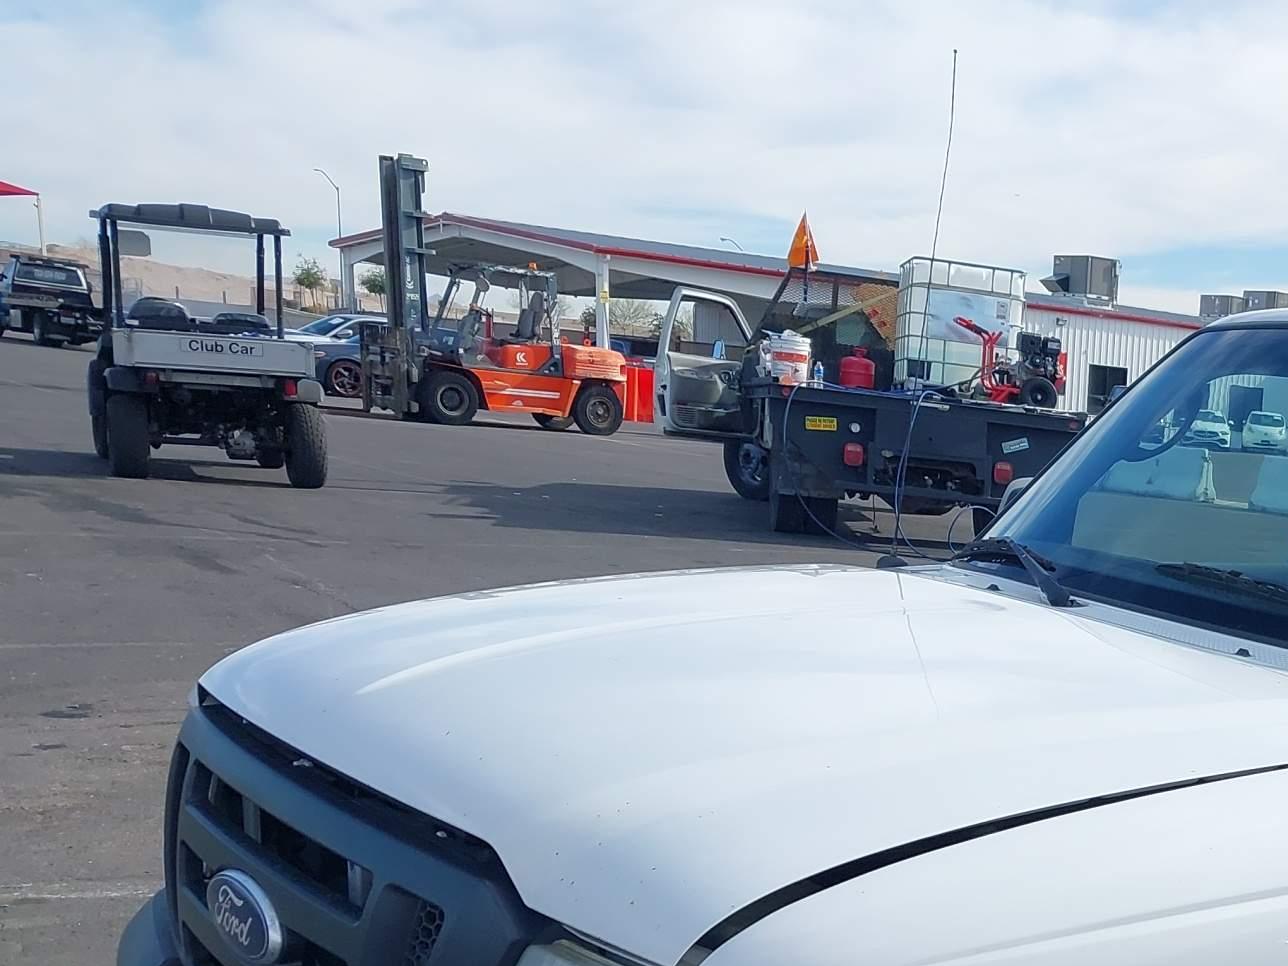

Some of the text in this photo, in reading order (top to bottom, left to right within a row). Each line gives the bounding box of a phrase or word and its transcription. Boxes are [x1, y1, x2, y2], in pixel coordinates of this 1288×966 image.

[188, 339, 256, 355] Club Car
[214, 884, 253, 947] Ford
